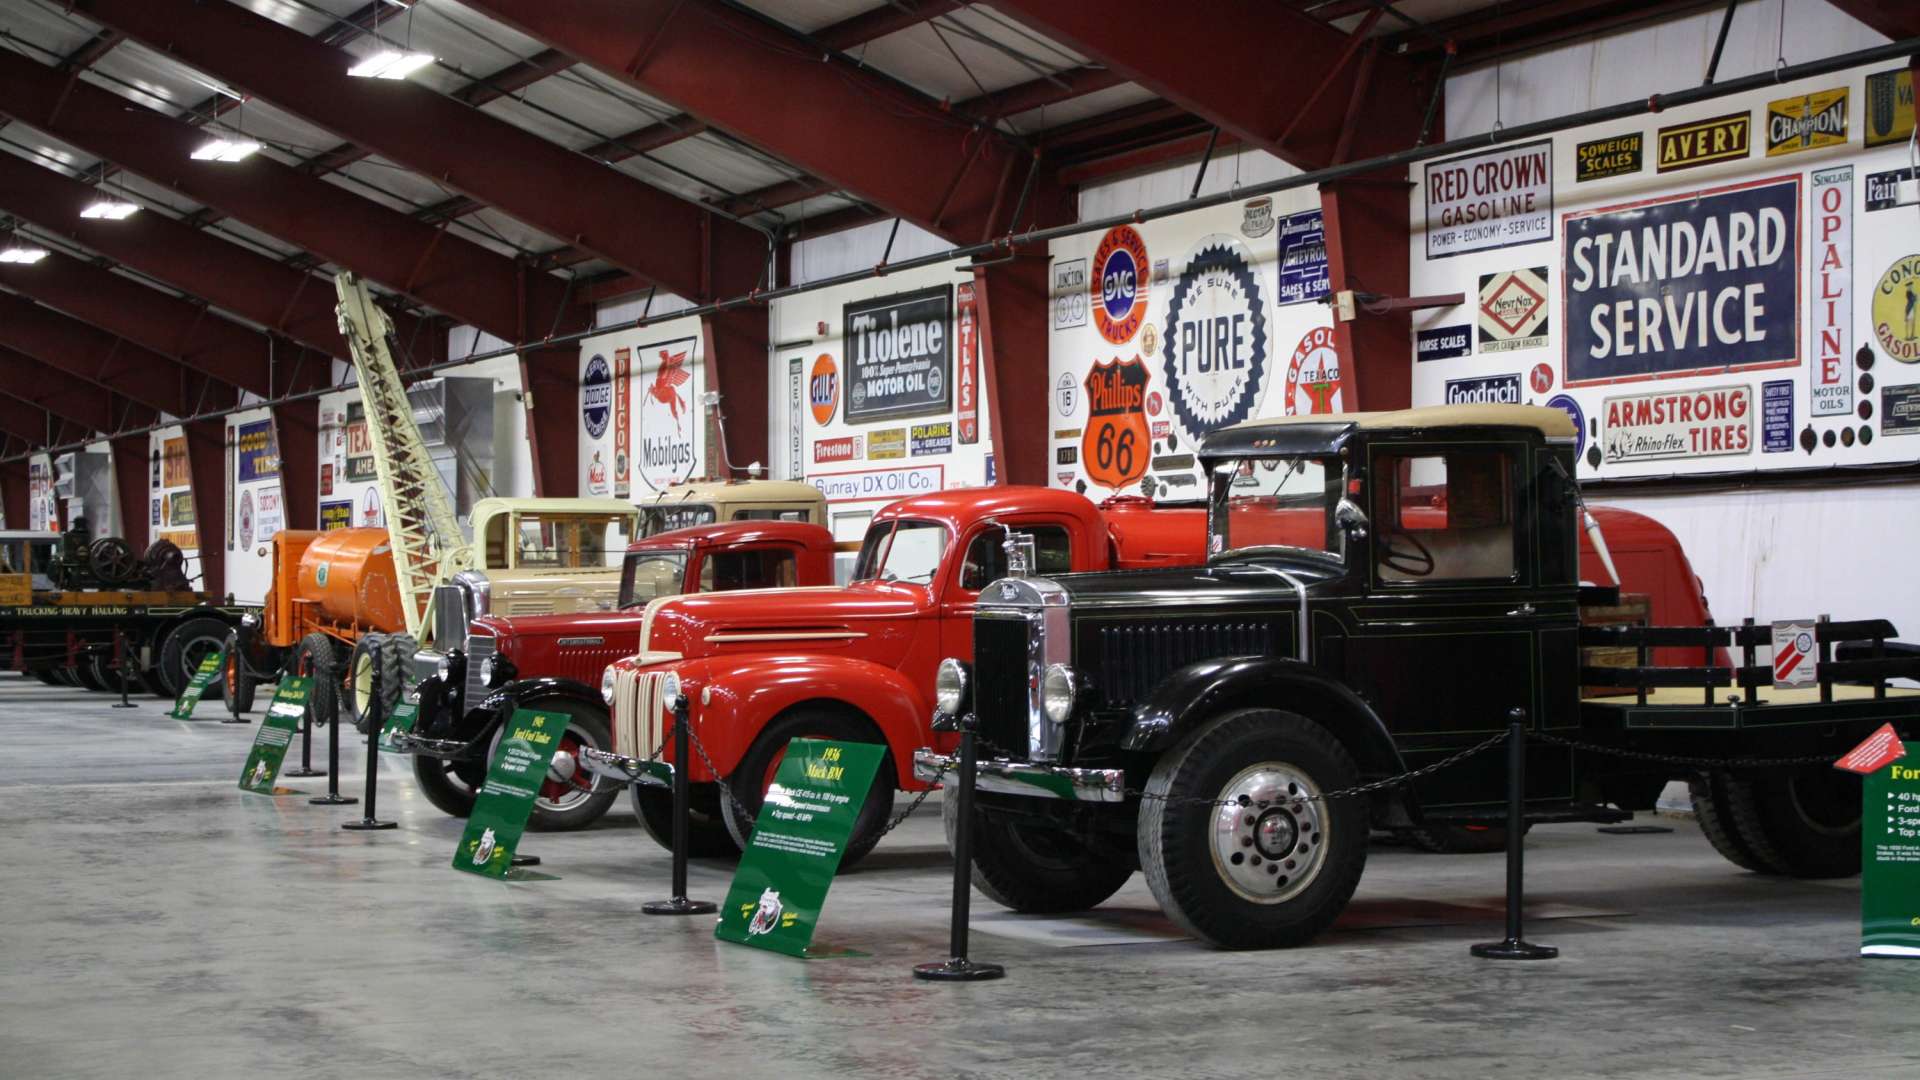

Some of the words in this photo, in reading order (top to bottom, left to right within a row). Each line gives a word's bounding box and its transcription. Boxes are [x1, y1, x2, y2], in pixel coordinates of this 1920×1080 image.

[1771, 102, 1843, 143] CHAMPION
[1579, 136, 1639, 162] SOWEIGH
[1664, 123, 1743, 162] AVERY
[1586, 151, 1632, 172] SCALES
[1430, 167, 1469, 204] RED
[1473, 152, 1547, 196] CROWN
[1813, 171, 1853, 187] SINCLAIR
[1441, 192, 1536, 227] GASOLINE
[1432, 231, 1456, 247] POWER
[1463, 224, 1502, 242] ECONOMY
[1508, 217, 1547, 235] SERVICE
[1286, 246, 1327, 267] CHEVROL
[1572, 207, 1787, 293] STANDARD
[1104, 270, 1135, 302] GMC
[1206, 277, 1239, 301] SURE
[1820, 187, 1843, 385] OPALINE
[1101, 314, 1138, 340] TRUCKS
[1590, 283, 1767, 360] SERVICE
[852, 310, 943, 366] Tiolene
[1181, 313, 1246, 376] PURE
[1440, 334, 1466, 350] SCALES
[961, 306, 973, 406] ATLAS
[811, 372, 837, 403] GULF
[867, 376, 904, 398] MOTOR
[905, 373, 926, 393] OIL
[1303, 368, 1340, 382] TEXACO
[584, 386, 610, 406] DODGE
[618, 358, 626, 446] DELCO
[1091, 370, 1143, 413] Phillips
[1213, 375, 1243, 412] PURE
[1449, 379, 1518, 405] Goodrich
[1813, 386, 1851, 398] MOTOR
[1820, 399, 1844, 410] OILS
[1607, 390, 1748, 429] ARMSTRONG
[912, 424, 951, 439] POLARINE
[1634, 433, 1685, 452] Rhino-Flex
[1689, 424, 1749, 453] TIRES
[643, 437, 690, 473] Mobilgas
[816, 442, 852, 461] Firestone
[1096, 422, 1135, 477] 66
[356, 457, 375, 476] AHEA
[815, 478, 860, 498] Sunray
[863, 475, 884, 493] DX
[887, 473, 905, 492] Oil
[908, 471, 933, 489] Co.
[806, 763, 828, 779] Mack
[1897, 793, 1911, 801] 40
[1897, 827, 1916, 837] Top
